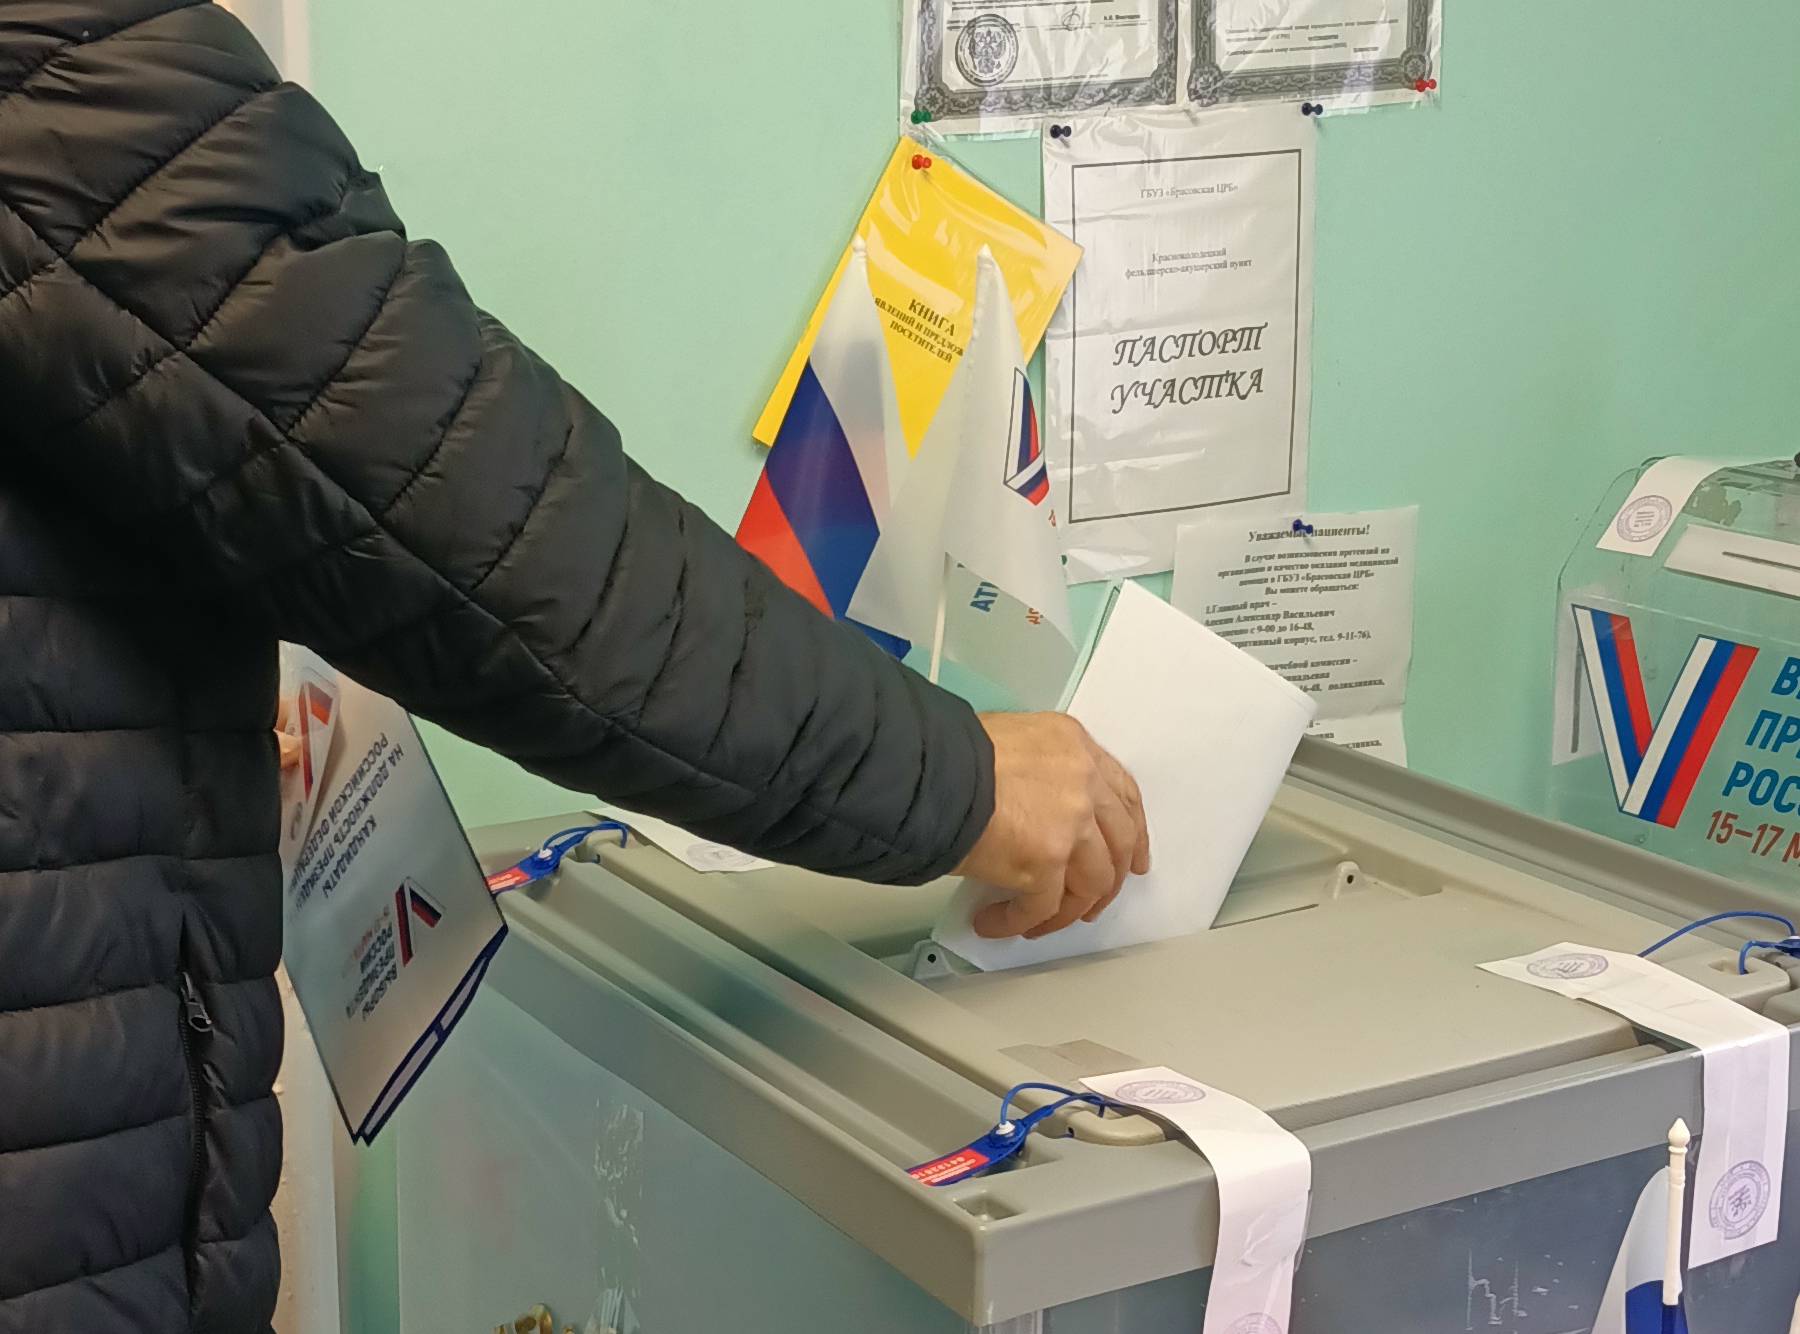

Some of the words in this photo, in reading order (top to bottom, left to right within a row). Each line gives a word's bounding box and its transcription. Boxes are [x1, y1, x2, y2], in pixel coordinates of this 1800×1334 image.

[1141, 187, 1163, 198] ГБУЗ
[1166, 187, 1214, 198] «Брасовская
[1217, 183, 1238, 193] ЦРБ»
[1152, 248, 1227, 266] Красноколодецкий
[1125, 260, 1227, 280] фельдшерско-акушерский
[1230, 260, 1252, 270] пункт
[875, 297, 916, 327] ЯВЛЕНИЙ
[915, 322, 923, 332] И
[923, 327, 963, 357] ПРЕДЛОЖ
[908, 298, 955, 336] КНИГА
[889, 320, 953, 363] ПОСЕТИТЕЛЕЙ
[1113, 322, 1268, 366] ПАСПОРТ
[1110, 368, 1264, 414] УЧАСТКА
[1252, 554, 1275, 563] случае
[1278, 551, 1337, 559] возникновения
[1339, 547, 1378, 558] претензий
[1274, 563, 1310, 572] качество
[1350, 557, 1398, 567] медицинской
[1277, 574, 1299, 582] ГБУЗ
[1301, 573, 1351, 583] «Брасовская
[1265, 587, 1277, 595] Вы
[1236, 613, 1281, 623] Александр
[1283, 610, 1335, 619] Васильевич
[1250, 601, 1270, 611] врач
[1257, 625, 1275, 633] 9-00
[1290, 622, 1314, 631] 16-48,
[1284, 637, 1317, 646] корпус,
[1310, 659, 1350, 667] комиссии
[1771, 656, 1800, 700] В
[1745, 709, 1800, 759] ПР
[388, 743, 404, 767] НА
[328, 732, 389, 825] РОССИЙСКОЙ
[1722, 760, 1800, 816] РОС
[334, 761, 389, 845] ДОЛЖНОСТЬ
[322, 815, 377, 899] КАНДИДАТЫ
